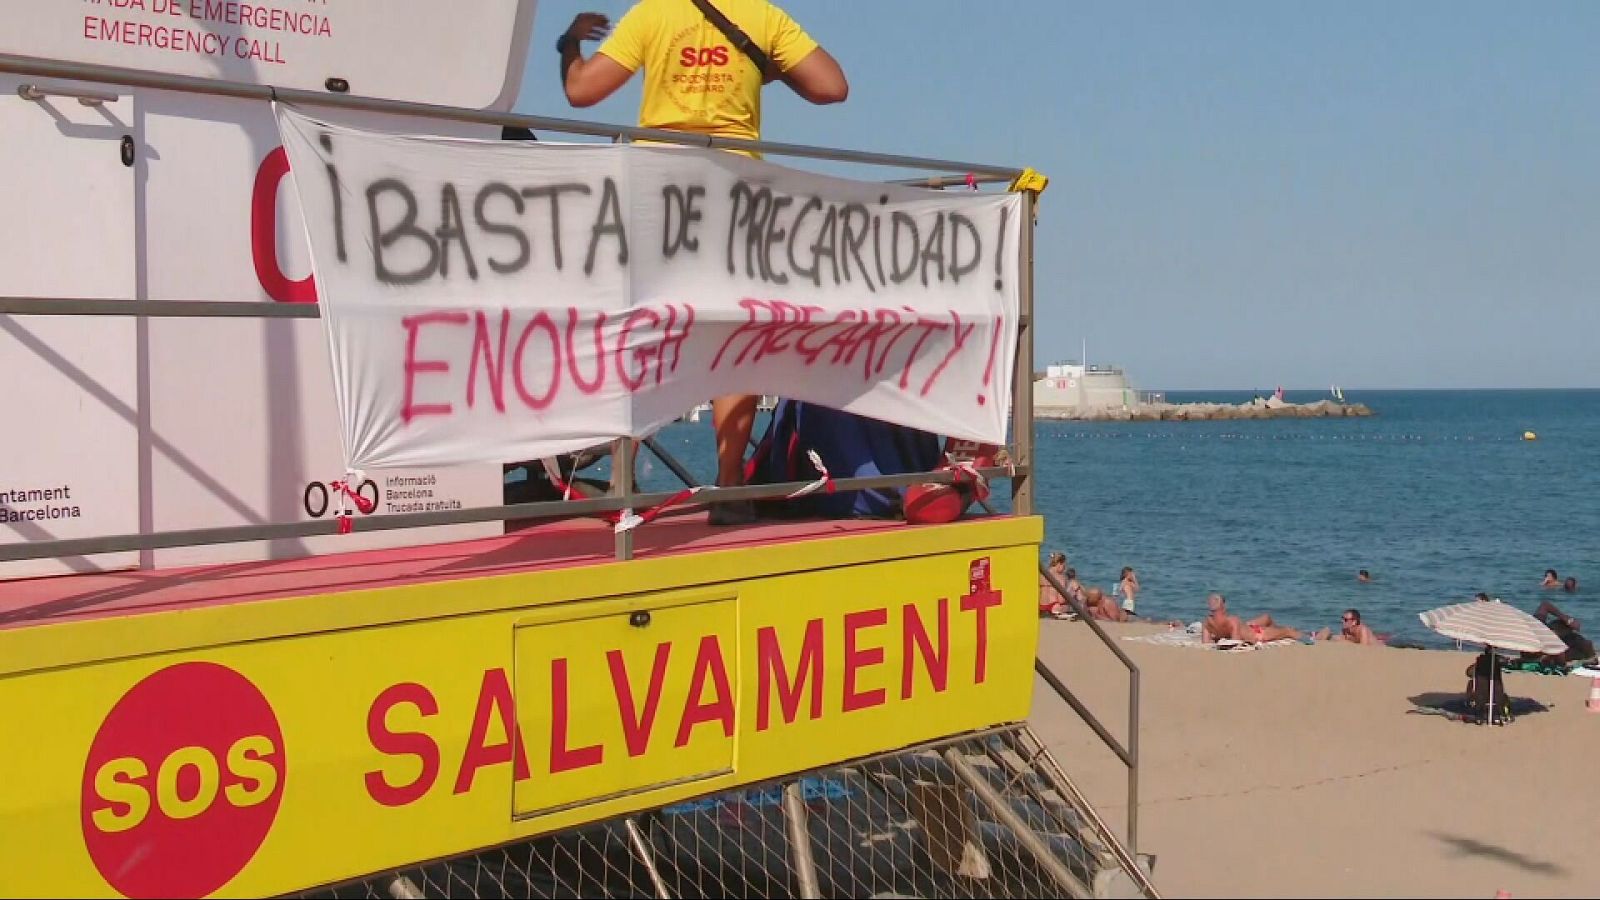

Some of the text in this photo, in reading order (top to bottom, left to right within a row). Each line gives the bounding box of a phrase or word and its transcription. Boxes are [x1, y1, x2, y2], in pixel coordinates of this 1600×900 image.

[153, 0, 332, 37] DE EMERGENCIA
[84, 16, 286, 64] EMERGENCY CALL
[680, 46, 729, 67] SOS
[661, 183, 706, 258] DE
[401, 302, 695, 425] ENOUGH
[0, 505, 81, 523] Barcelona
[386, 488, 434, 501] Barcelona
[386, 500, 463, 513] Trucada gratuita
[364, 589, 1003, 808] SALVAMENT
[91, 734, 278, 833] SOS
